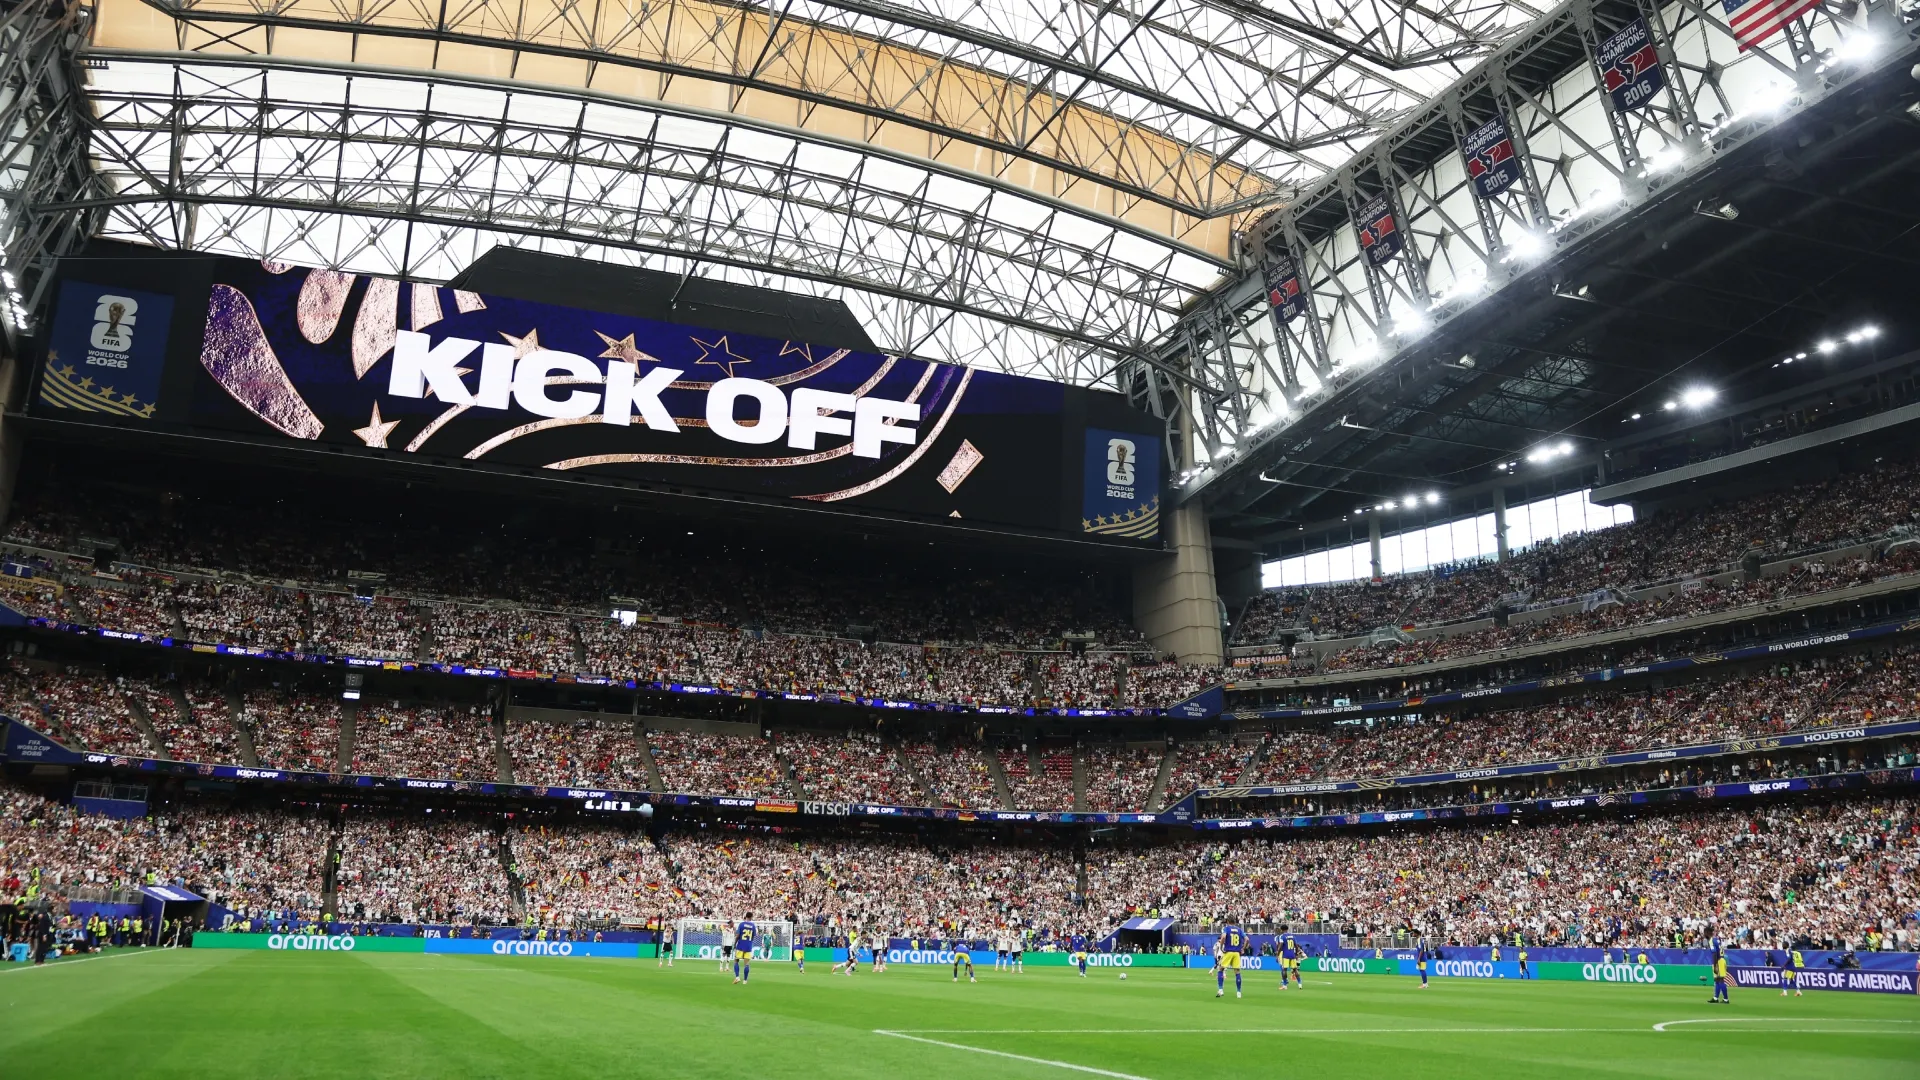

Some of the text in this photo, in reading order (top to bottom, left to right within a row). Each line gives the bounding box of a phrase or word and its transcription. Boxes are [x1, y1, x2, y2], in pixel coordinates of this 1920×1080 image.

[1600, 28, 1646, 65] CHAMPIONS
[1602, 24, 1638, 54] AFC SOUTH
[1624, 80, 1652, 106] 2016
[1464, 125, 1504, 155] CHAMPIONS
[1467, 120, 1497, 144] AFC SOUTH
[1484, 170, 1509, 192] 2015
[1373, 242, 1392, 262] 2012
[1282, 302, 1296, 319] 2011
[102, 338, 120, 346] FIFA
[88, 350, 114, 358] WORLD
[86, 356, 128, 369] 2026
[388, 329, 921, 459] KICK OFF
[1106, 490, 1134, 499] 2026
[1784, 640, 1809, 650] WORLD
[1824, 633, 1849, 642] 2026
[1461, 688, 1502, 698] HOUSTON
[1804, 729, 1865, 742] HOUSTON
[1456, 770, 1498, 778] HOUSTON
[1749, 782, 1790, 792] KICK OFF
[804, 801, 850, 816] KETSCH
[268, 934, 355, 950] aramco
[424, 930, 441, 938] IFA
[742, 929, 753, 941] 24
[1230, 933, 1239, 946] 18
[493, 940, 572, 956] aramco
[699, 945, 772, 959] arco
[1287, 940, 1294, 950] 10
[1068, 953, 1132, 966] aamco
[1318, 957, 1365, 973] aramco
[1435, 960, 1493, 977] aramco
[1582, 963, 1656, 983] aramco
[1737, 970, 1779, 984] UNITED
[1828, 972, 1845, 987] OF
[1849, 973, 1912, 990] AMERICA
